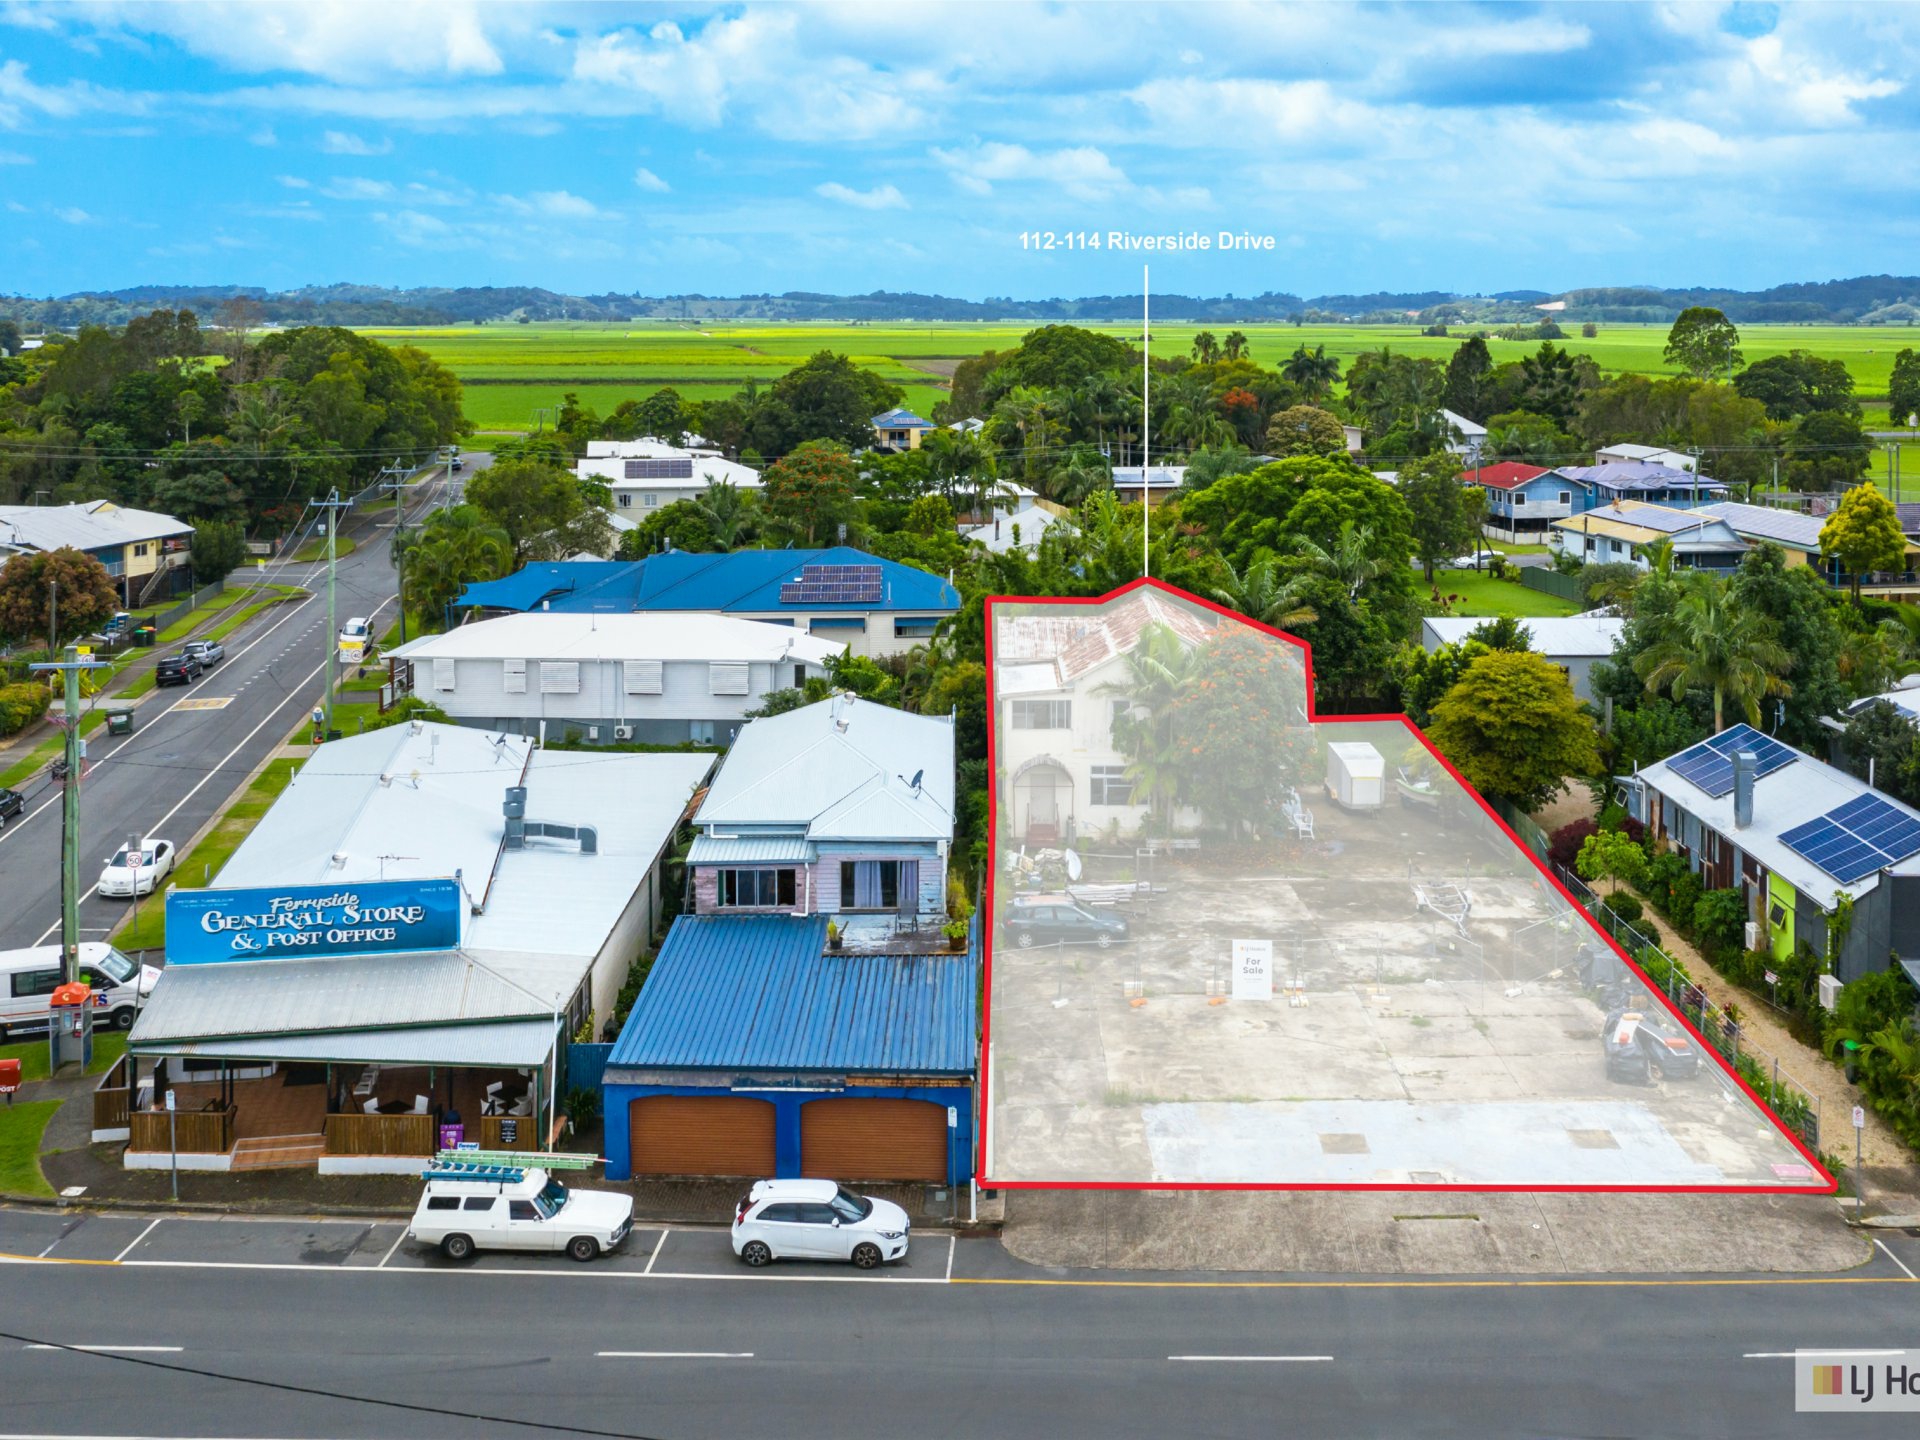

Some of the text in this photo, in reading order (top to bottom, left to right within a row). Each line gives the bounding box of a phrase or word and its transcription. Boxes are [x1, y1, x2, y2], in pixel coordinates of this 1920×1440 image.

[129, 857, 140, 865] 50
[268, 892, 360, 913] Ferryside
[201, 905, 426, 933] GENERAL STORE
[231, 928, 396, 950] & POST OFFICE
[1246, 957, 1261, 966] For
[1242, 966, 1264, 975] Sale
